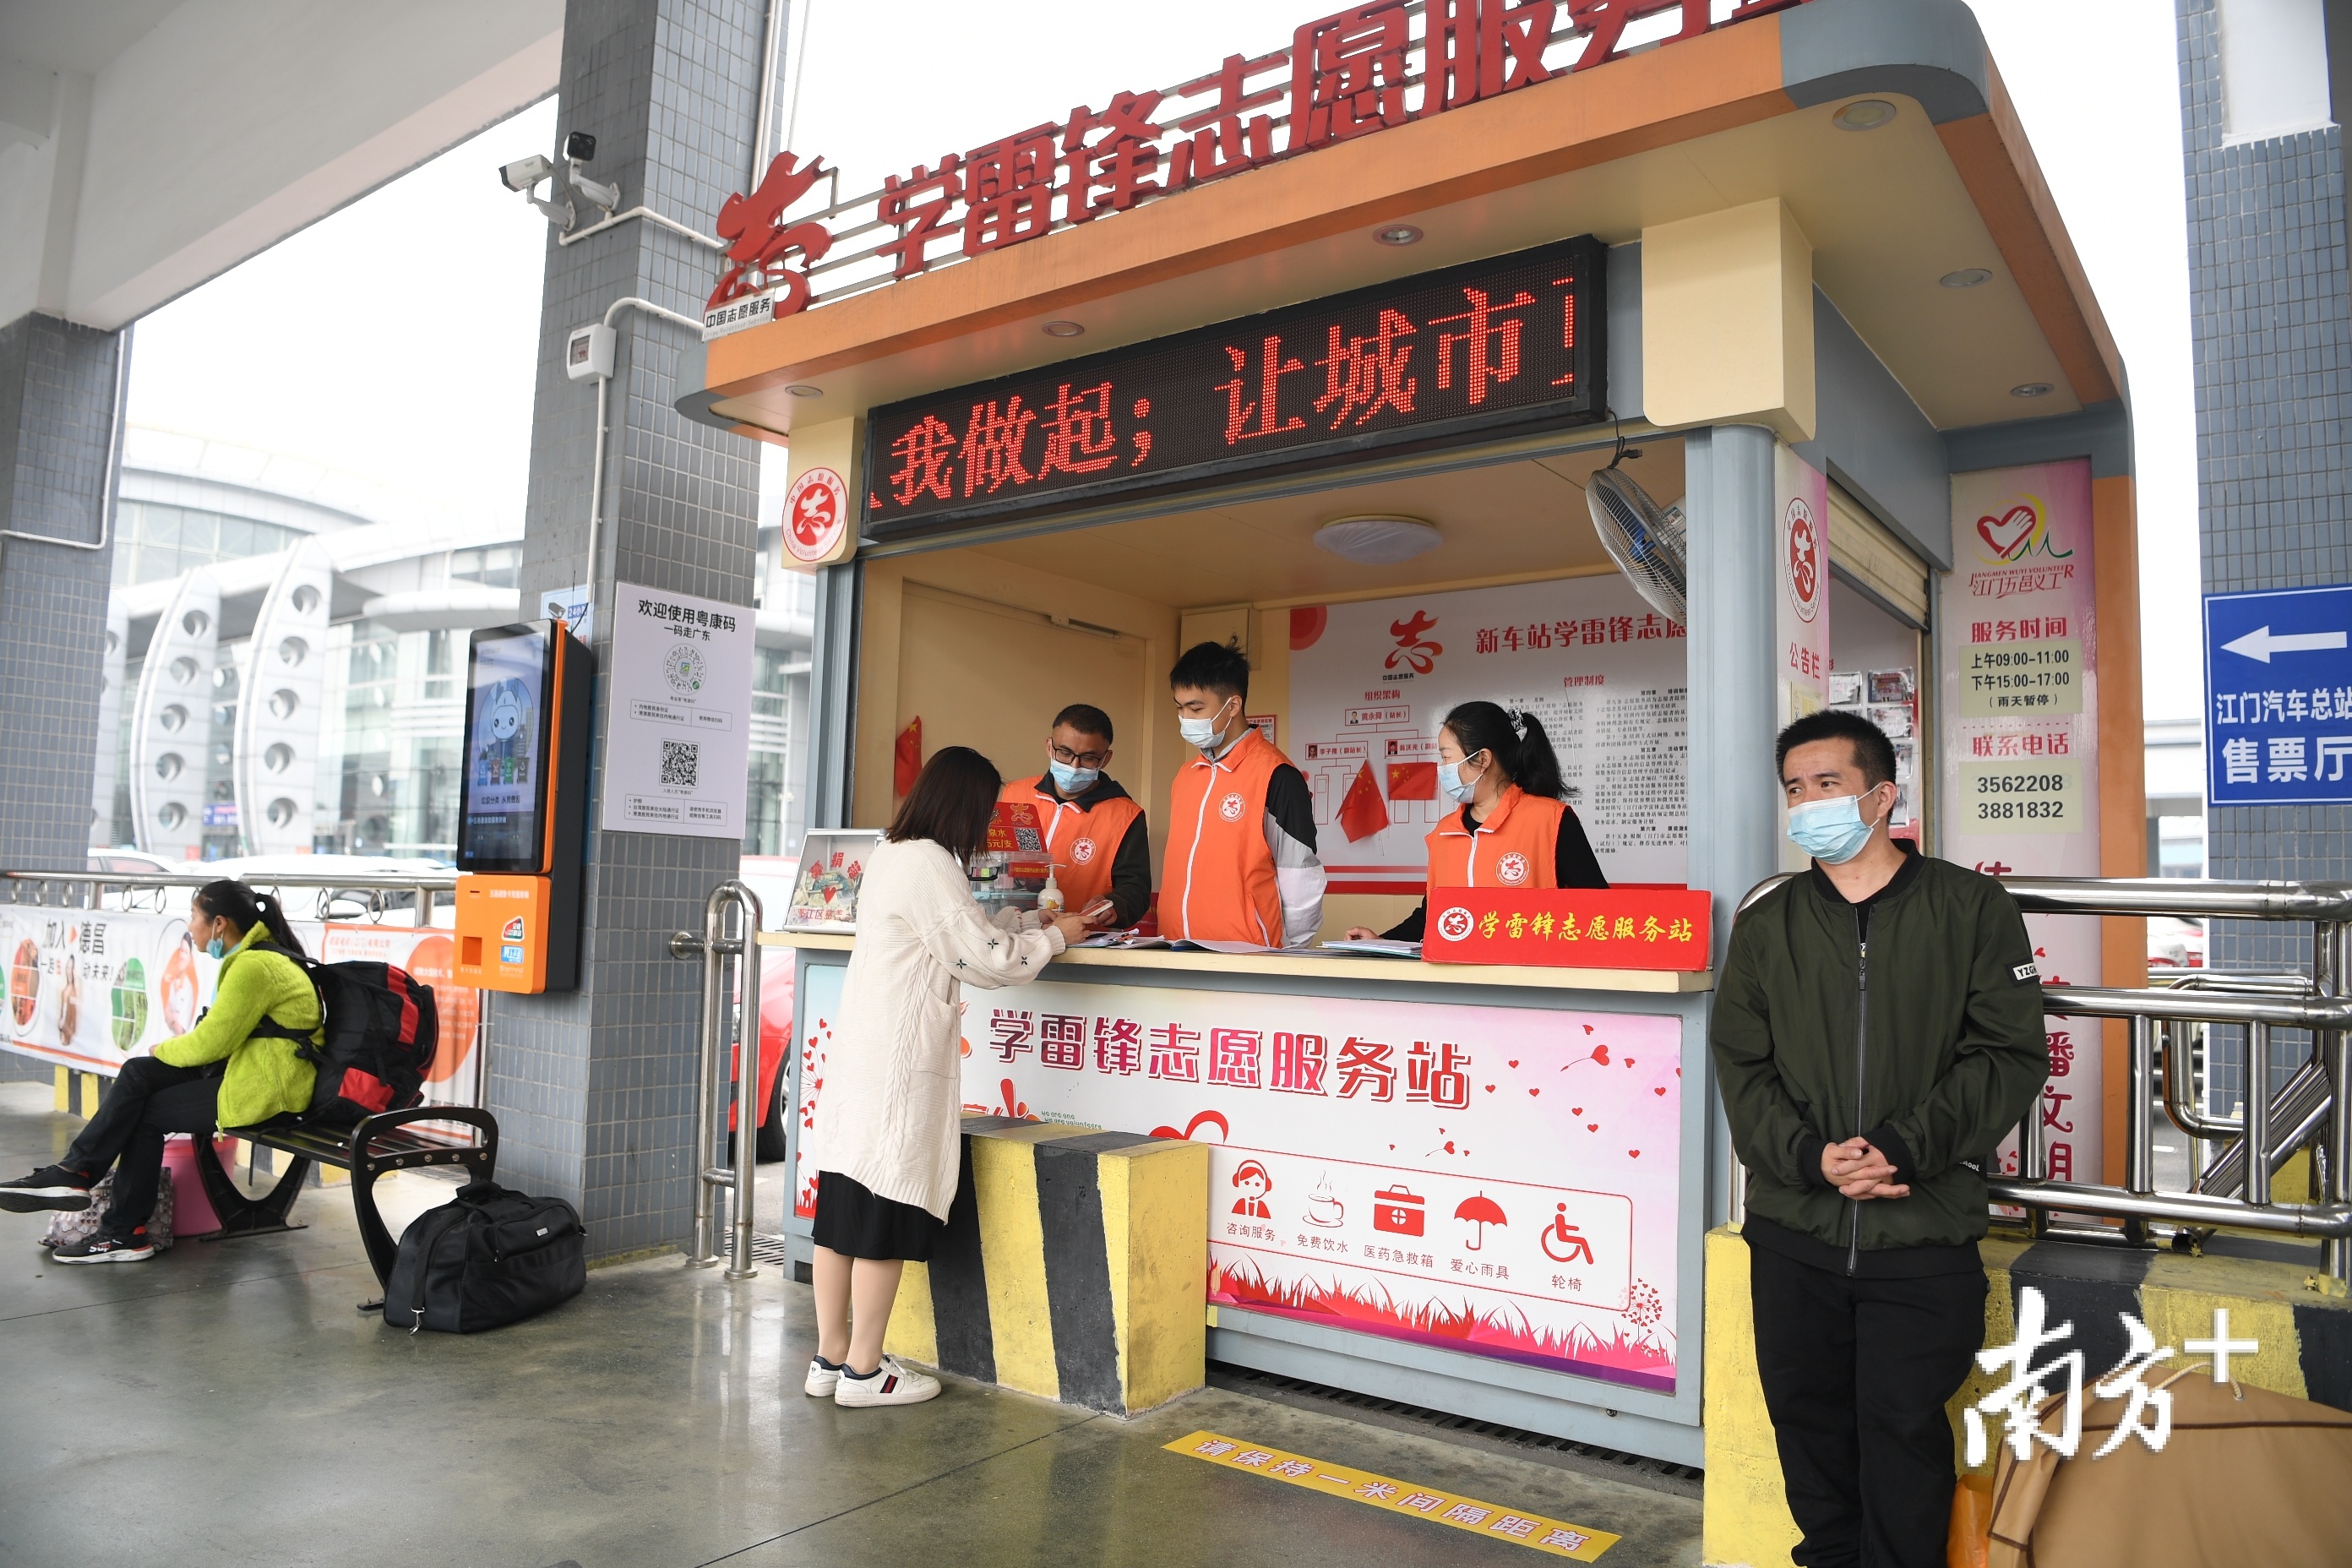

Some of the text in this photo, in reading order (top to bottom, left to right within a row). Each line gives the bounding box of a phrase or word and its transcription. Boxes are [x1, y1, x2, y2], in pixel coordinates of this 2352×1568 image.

[876, 0, 1799, 279] 学雷锋志愿服务
[706, 297, 770, 328] 中国志愿服务
[870, 381, 1152, 509] 我做起；
[1968, 564, 2075, 587] JIANGMEN WUYI VOLUNTEER
[1973, 573, 2063, 598] 江门五邑义工
[638, 599, 736, 633] 欢迎使用粤康码
[664, 624, 711, 641] 一码走广东
[1971, 617, 2068, 643] 服务时间
[1789, 641, 1821, 679] 公告栏
[1971, 650, 2069, 669] 上午09:00-11:00
[1564, 674, 1604, 688] 管理制度
[1971, 672, 2070, 691] 下午15:00-17:00
[1364, 689, 1401, 701] 组织架构
[2216, 686, 2352, 725] 江门汽车总站
[1973, 732, 2069, 757] 联系电话
[2222, 736, 2352, 785] 售票厅
[1977, 775, 2063, 794] 3562208
[1977, 801, 2064, 819] 3881832
[1478, 910, 1693, 943] 学雷锋志愿服务站
[989, 1008, 1472, 1110] 学雷锋志愿服务站
[1226, 1222, 1276, 1243] 咨询服务
[1297, 1233, 1348, 1253] 免费饮水
[1364, 1244, 1434, 1269] 医药急救箱
[1450, 1258, 1510, 1280] 爱心雨具
[1551, 1274, 1582, 1292] 轮椅
[1192, 1438, 1592, 1553] 请保持一米间隔距离
